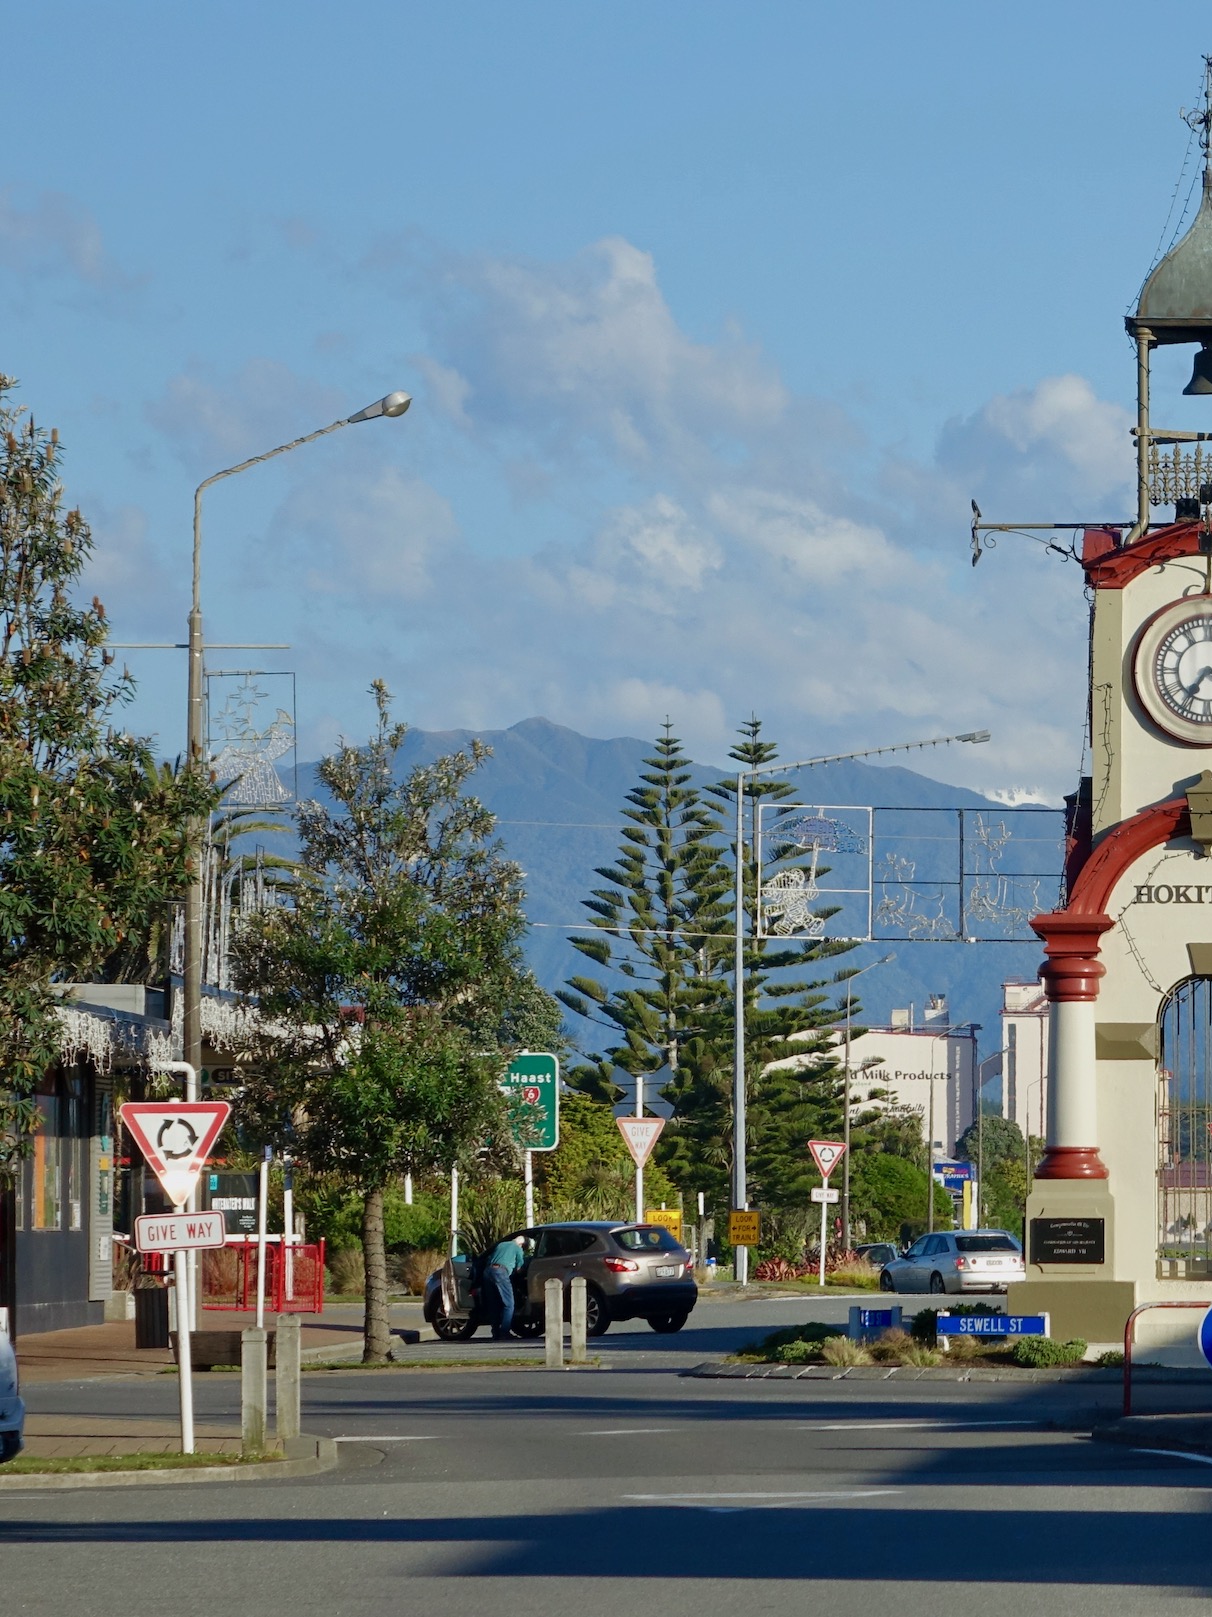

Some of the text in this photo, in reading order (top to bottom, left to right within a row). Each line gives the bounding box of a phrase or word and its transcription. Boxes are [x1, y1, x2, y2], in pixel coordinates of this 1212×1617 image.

[510, 1072, 552, 1083] Haast
[863, 1069, 889, 1080] Milk
[895, 1069, 952, 1080] Products
[632, 1127, 650, 1136] GIVE
[148, 1222, 213, 1241] GIVE WAY
[959, 1318, 1023, 1332] SEWELL ST
